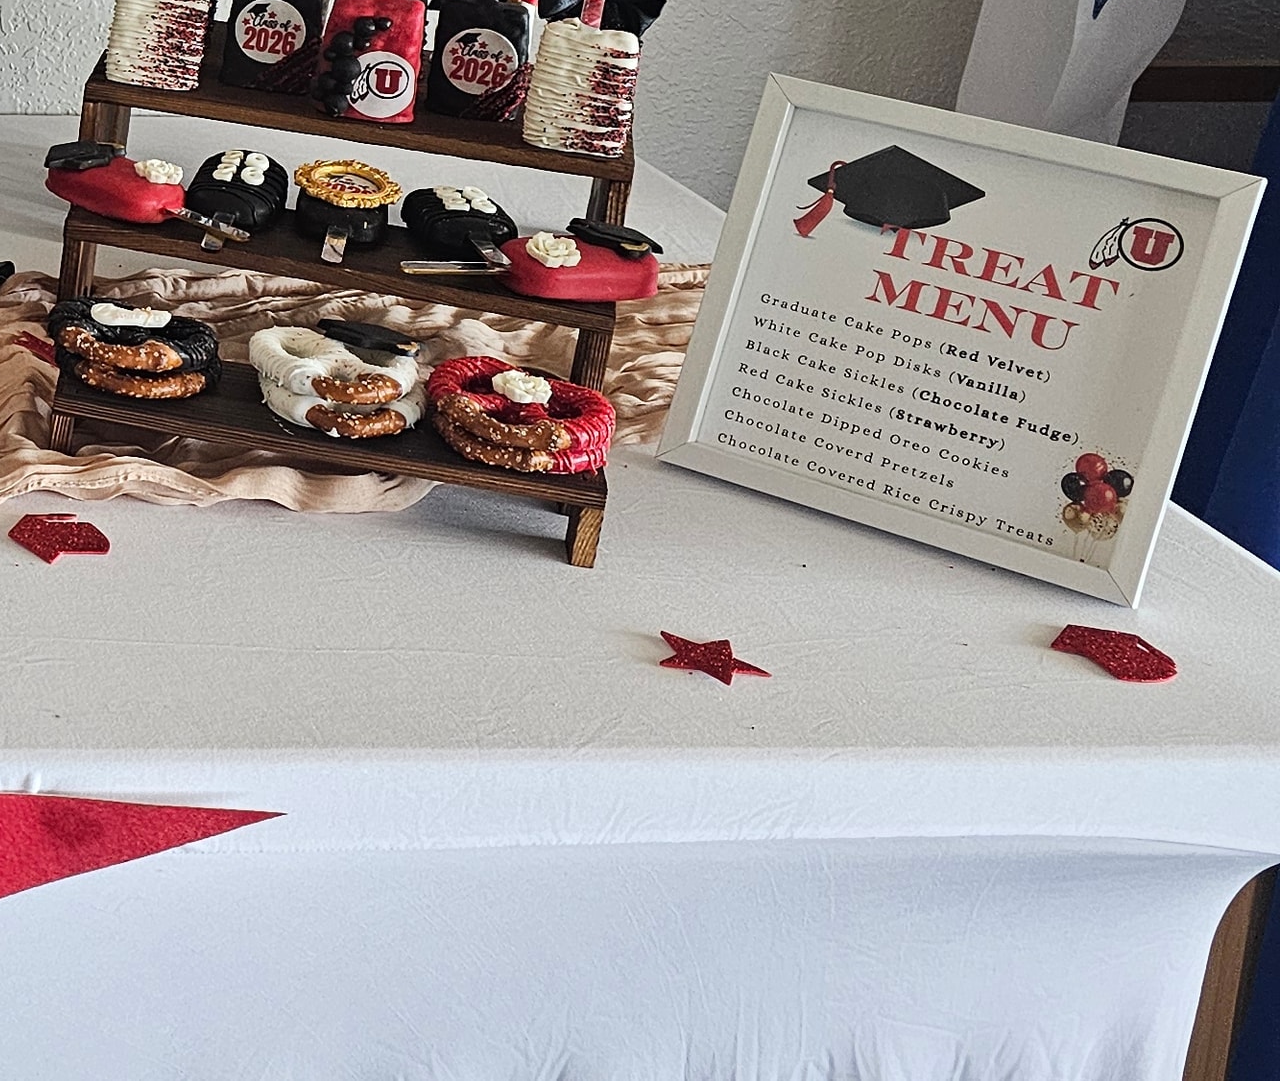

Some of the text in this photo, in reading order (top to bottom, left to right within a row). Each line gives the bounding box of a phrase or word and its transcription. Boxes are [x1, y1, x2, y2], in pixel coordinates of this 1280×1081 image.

[241, 26, 296, 57] 2026
[449, 55, 508, 88] 2026
[864, 269, 1080, 351] MENU
[880, 224, 1120, 311] TREAT
[754, 316, 1026, 404] White Cake Pop Disks (Vanilla)
[760, 293, 1051, 383] Graduate Cake Pops (Red Velvet)
[732, 386, 1009, 478] Chocolate Dipped Oreo Cookies
[738, 363, 1005, 451] Red Cake Sickles (Strawberry)
[745, 339, 1079, 445] Black Cake Sickles (Chocolate Fudge)
[717, 432, 1054, 546] Chocolate Covered Rice Crispy Treats
[724, 409, 955, 488] Chocolate Coverd Pretzels
